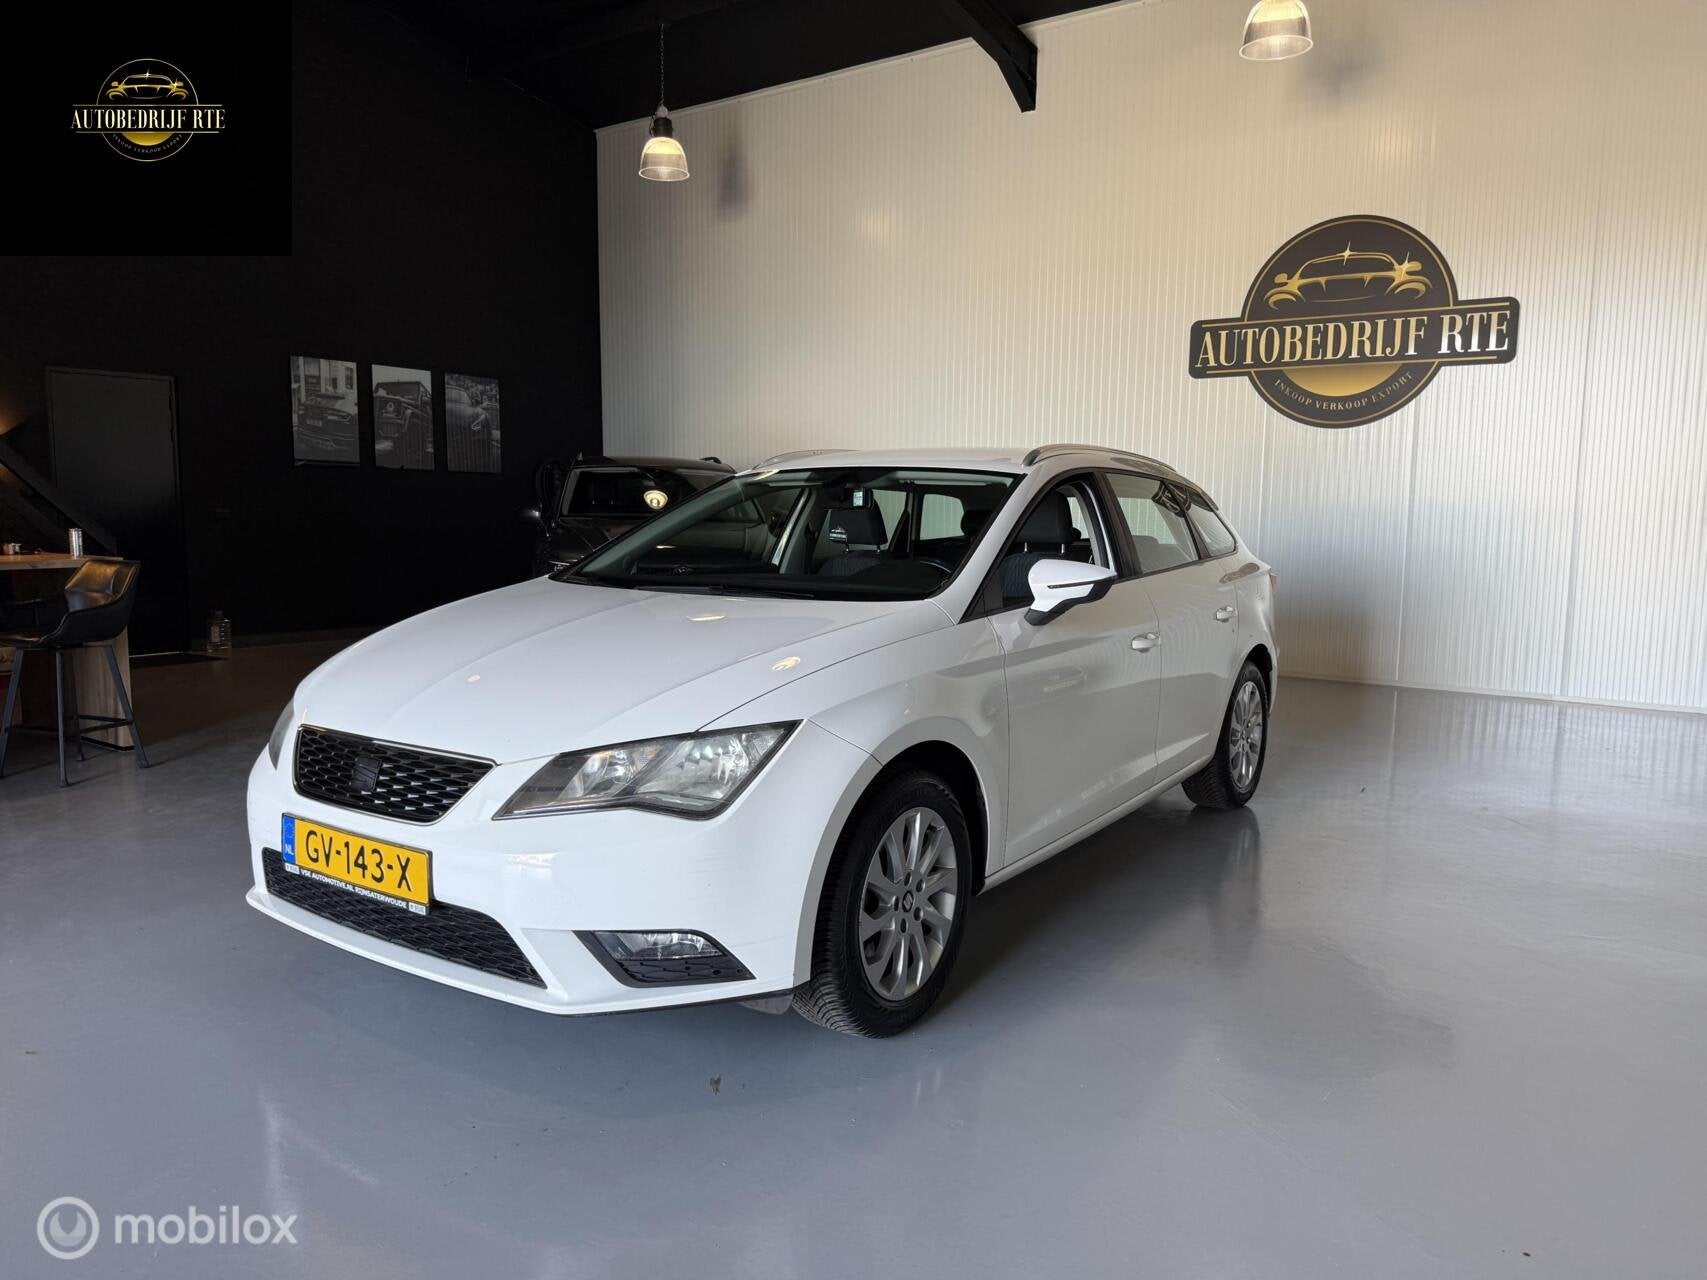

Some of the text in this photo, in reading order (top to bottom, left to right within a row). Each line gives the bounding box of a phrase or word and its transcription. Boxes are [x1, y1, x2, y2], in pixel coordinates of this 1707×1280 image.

[1194, 310, 1511, 368] AUTOBEDRIJF RTE
[1274, 371, 1412, 411] INKOOP VERKOOP EXPORT
[305, 829, 413, 892] GV-143-X
